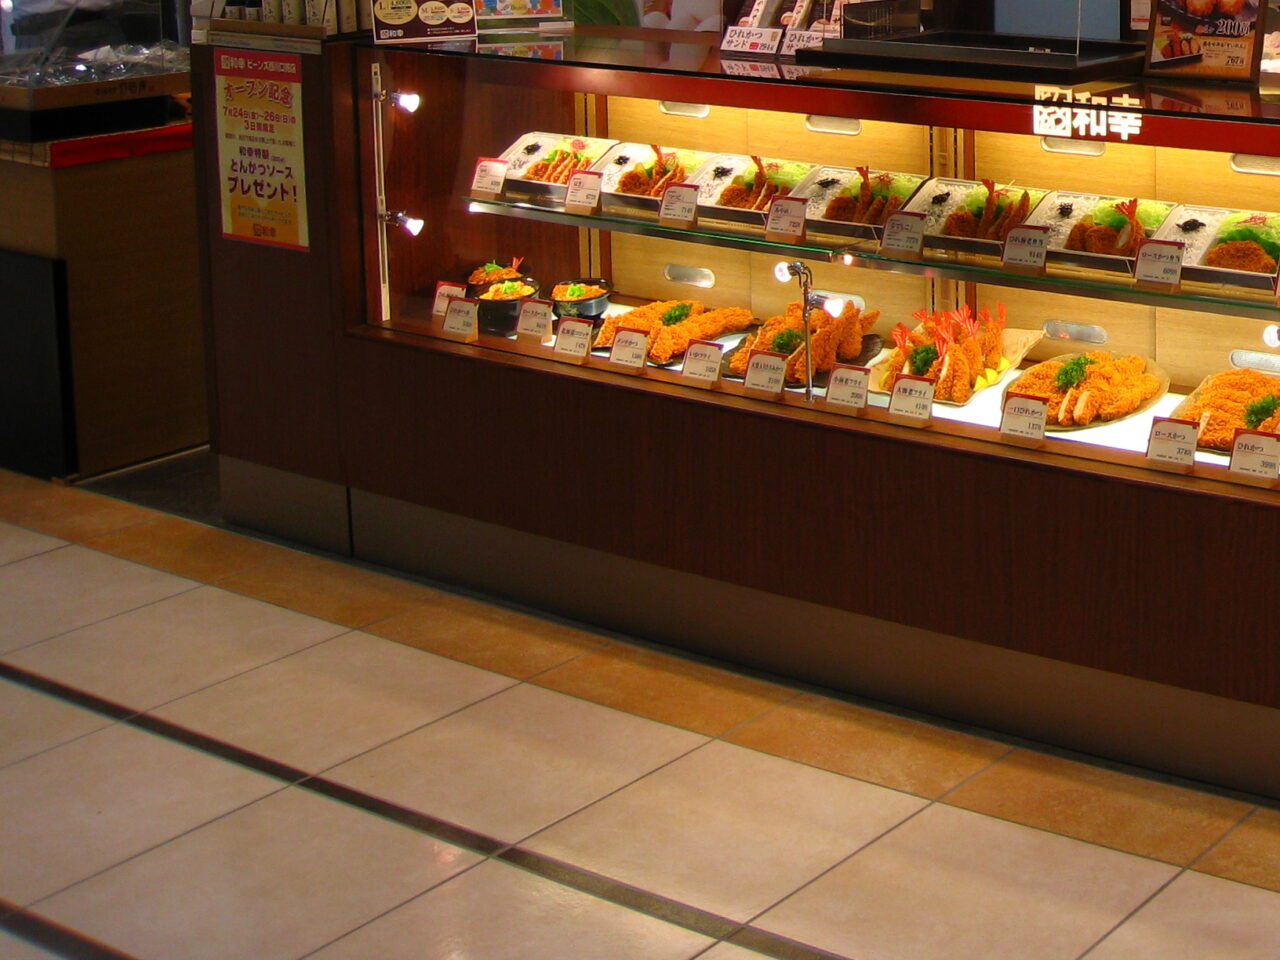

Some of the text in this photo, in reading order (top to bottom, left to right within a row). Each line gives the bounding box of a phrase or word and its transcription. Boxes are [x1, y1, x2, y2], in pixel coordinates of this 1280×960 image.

[728, 29, 763, 39] ひれかつ
[726, 40, 748, 49] サンド
[1072, 106, 1143, 140] 和幸
[230, 159, 294, 180] とんかつソース
[1154, 430, 1186, 441] ロースかつ
[1237, 442, 1264, 452] ひれかつ
